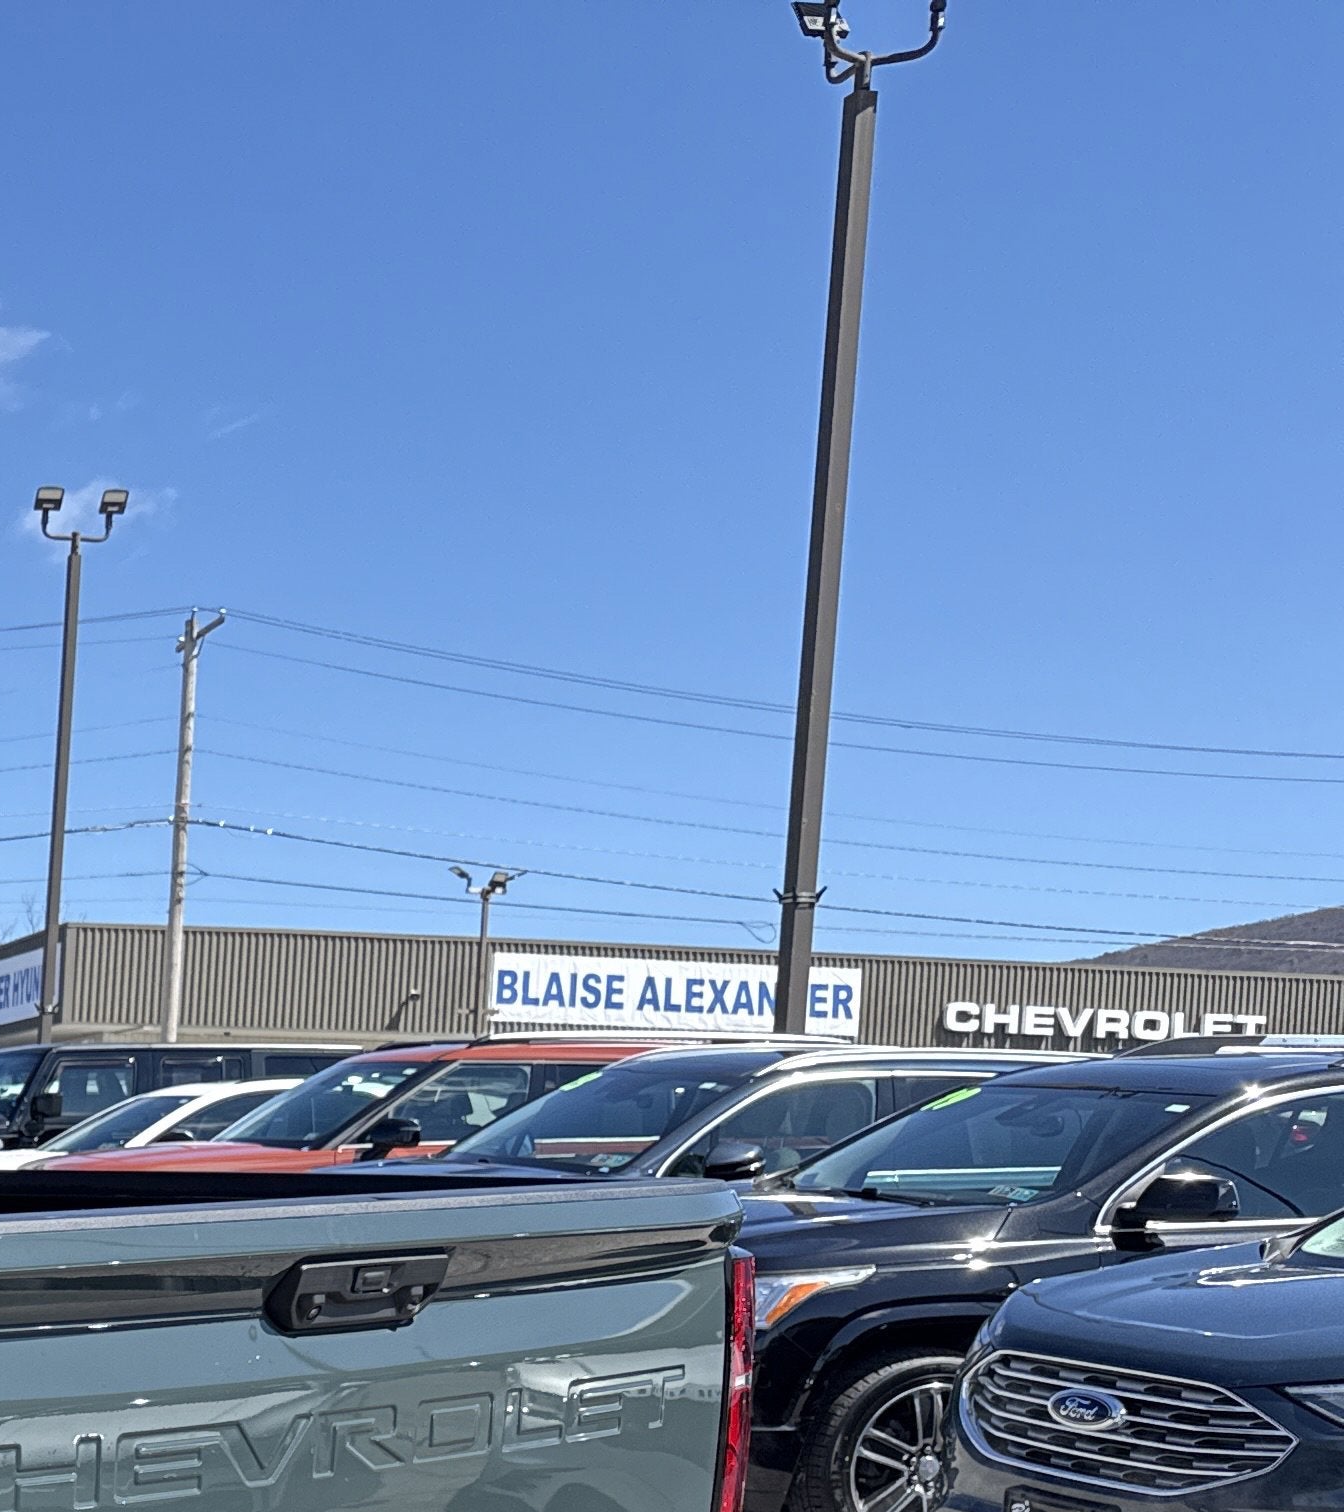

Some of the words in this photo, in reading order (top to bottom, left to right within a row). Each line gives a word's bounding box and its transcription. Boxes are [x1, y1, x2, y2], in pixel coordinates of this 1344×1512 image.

[13, 965, 43, 1007] HYUN
[495, 969, 625, 1009] BLAISE
[637, 976, 854, 1019] ALEXANER
[944, 1001, 1266, 1041] CHEVROLET
[1060, 1396, 1099, 1420] Ford
